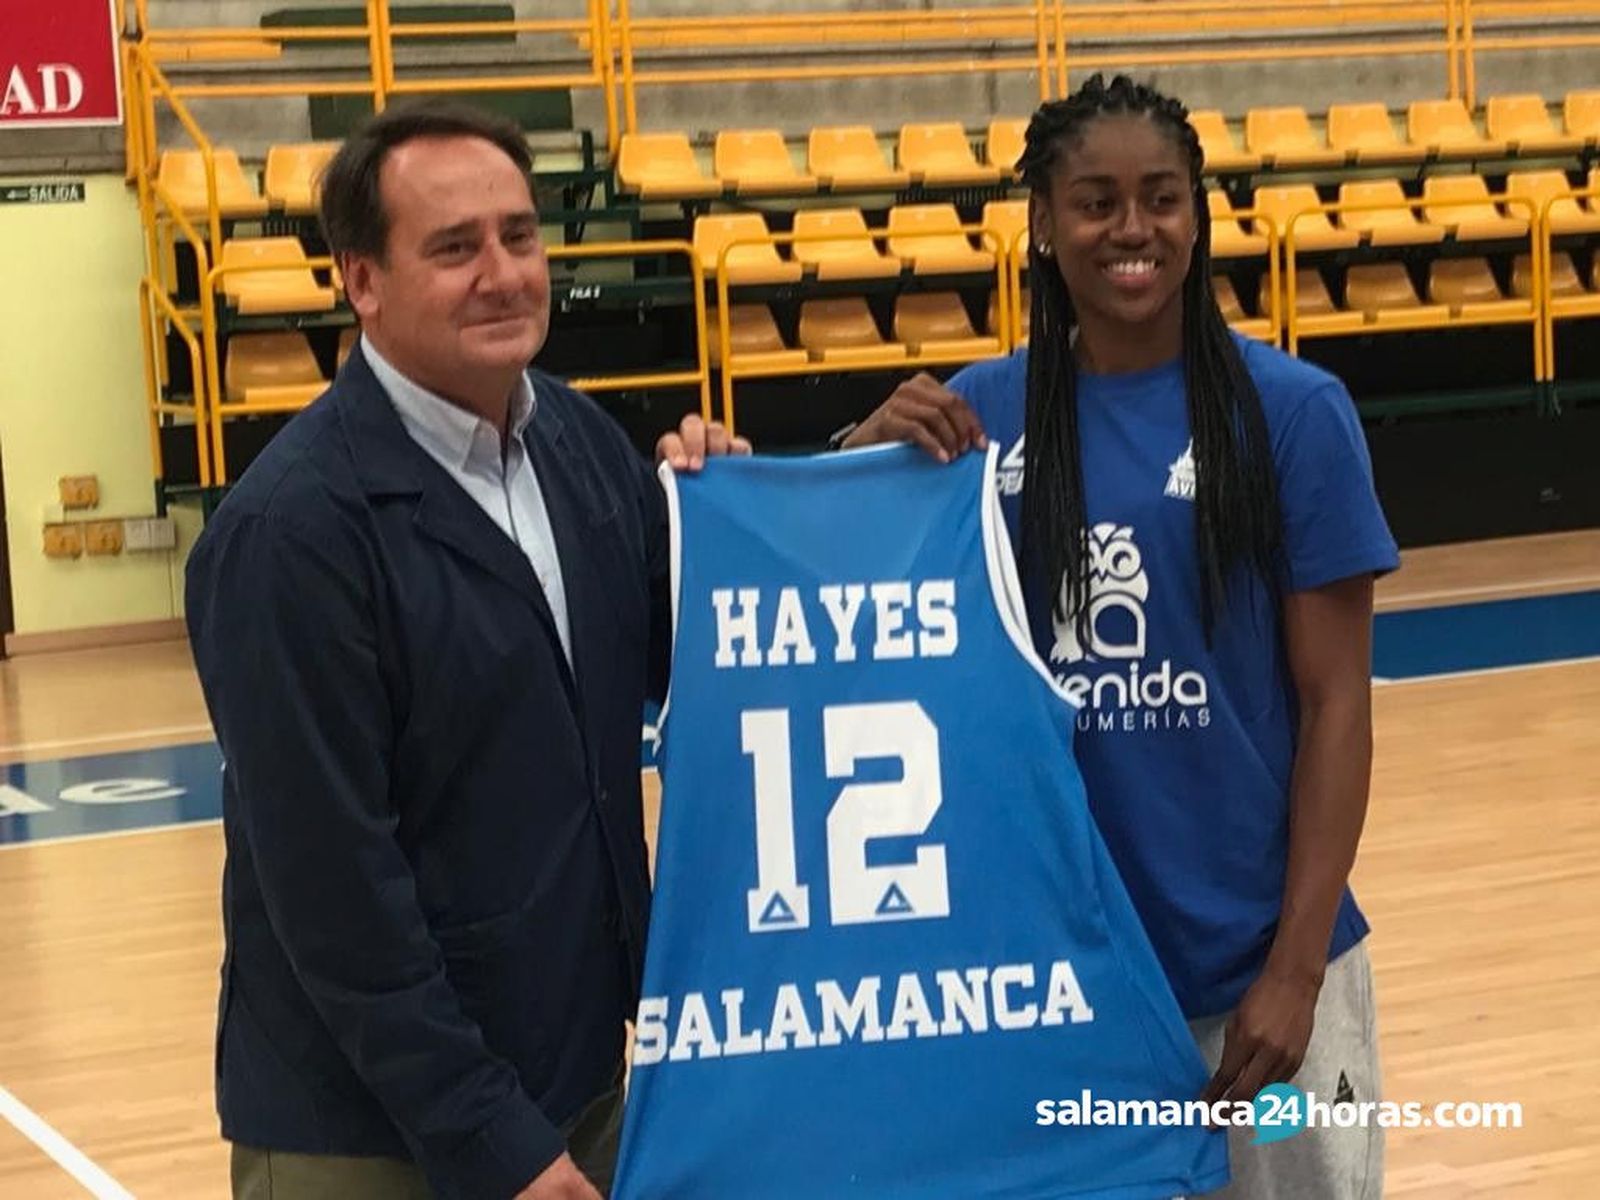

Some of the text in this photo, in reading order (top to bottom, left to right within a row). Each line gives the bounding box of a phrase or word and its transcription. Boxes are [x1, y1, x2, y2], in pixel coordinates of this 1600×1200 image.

[29, 184, 79, 202] SALIDA
[712, 579, 959, 668] HAYES
[1053, 659, 1208, 709] enida
[740, 700, 951, 933] 12
[632, 960, 1094, 1066] SALAMANCA
